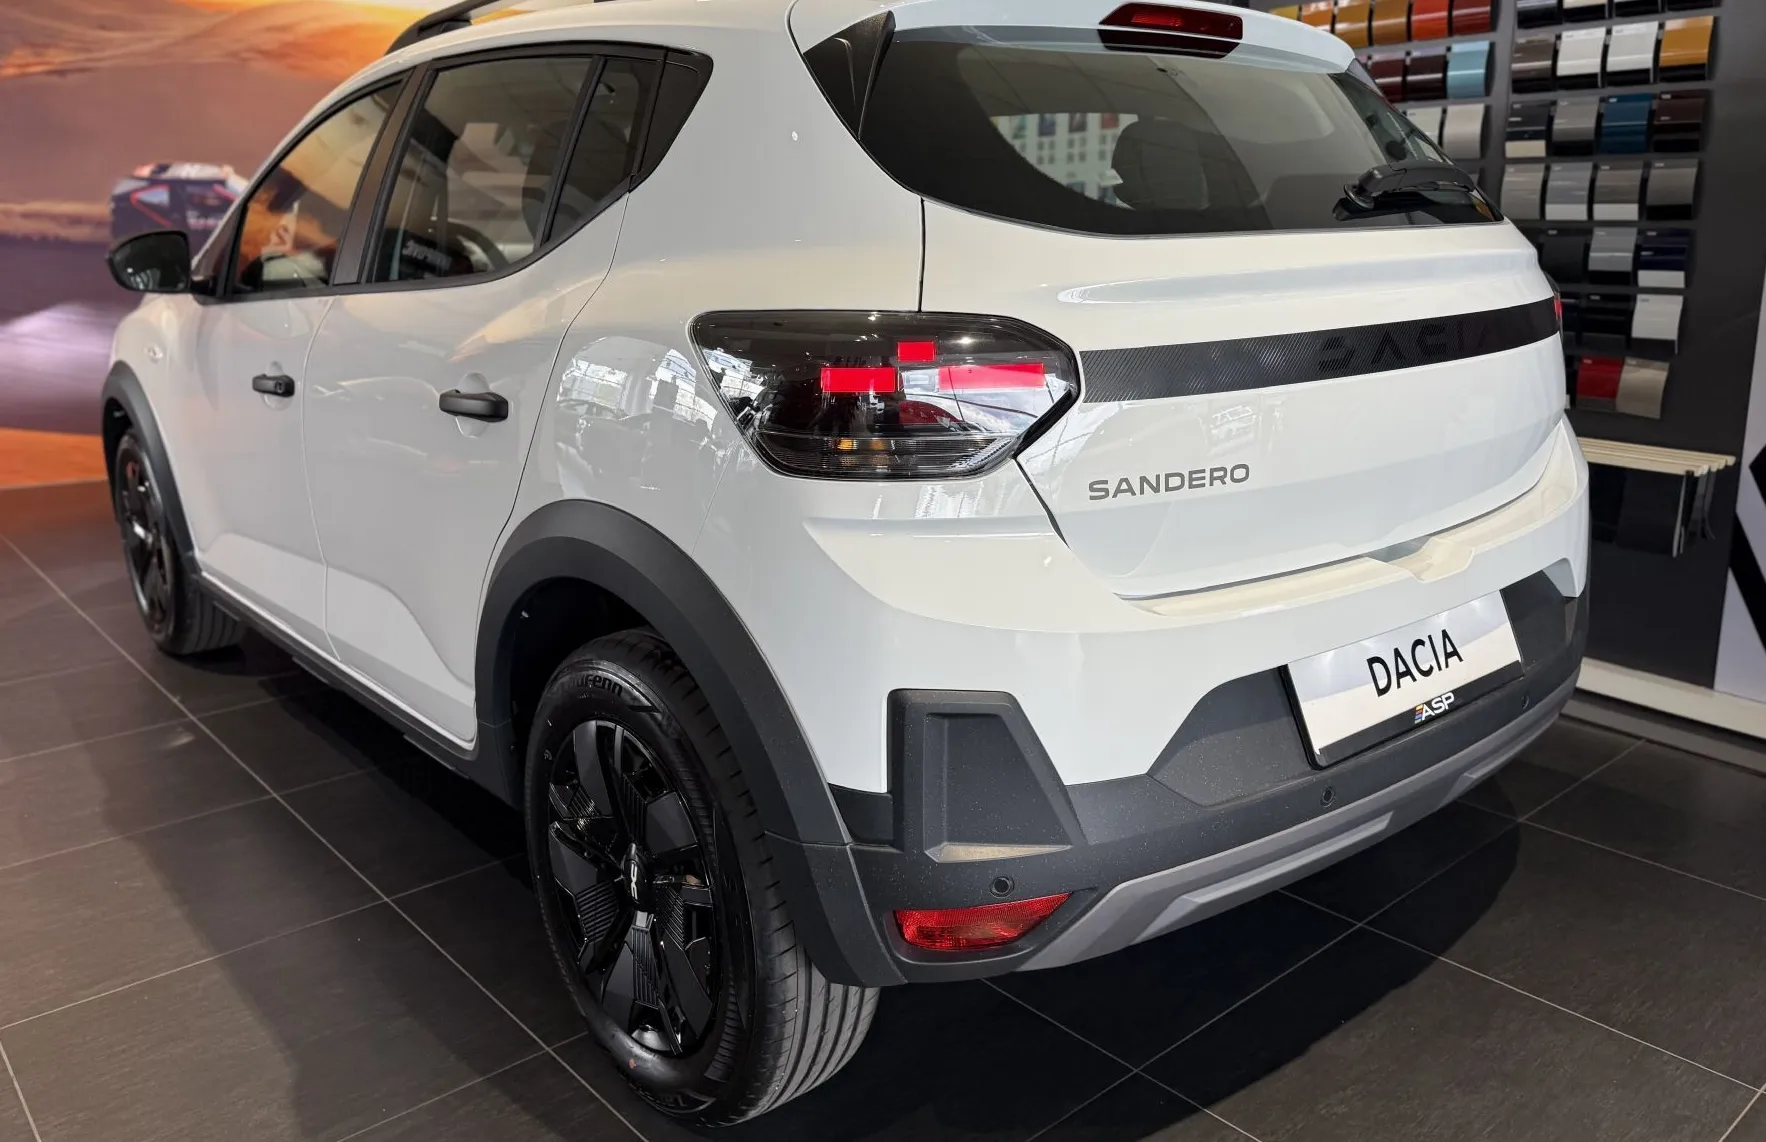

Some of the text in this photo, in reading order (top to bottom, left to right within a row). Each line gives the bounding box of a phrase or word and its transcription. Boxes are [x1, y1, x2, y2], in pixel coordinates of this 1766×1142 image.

[1088, 463, 1250, 500] SANDERO
[1366, 629, 1464, 697] DACIA
[1421, 691, 1455, 721] ASP
